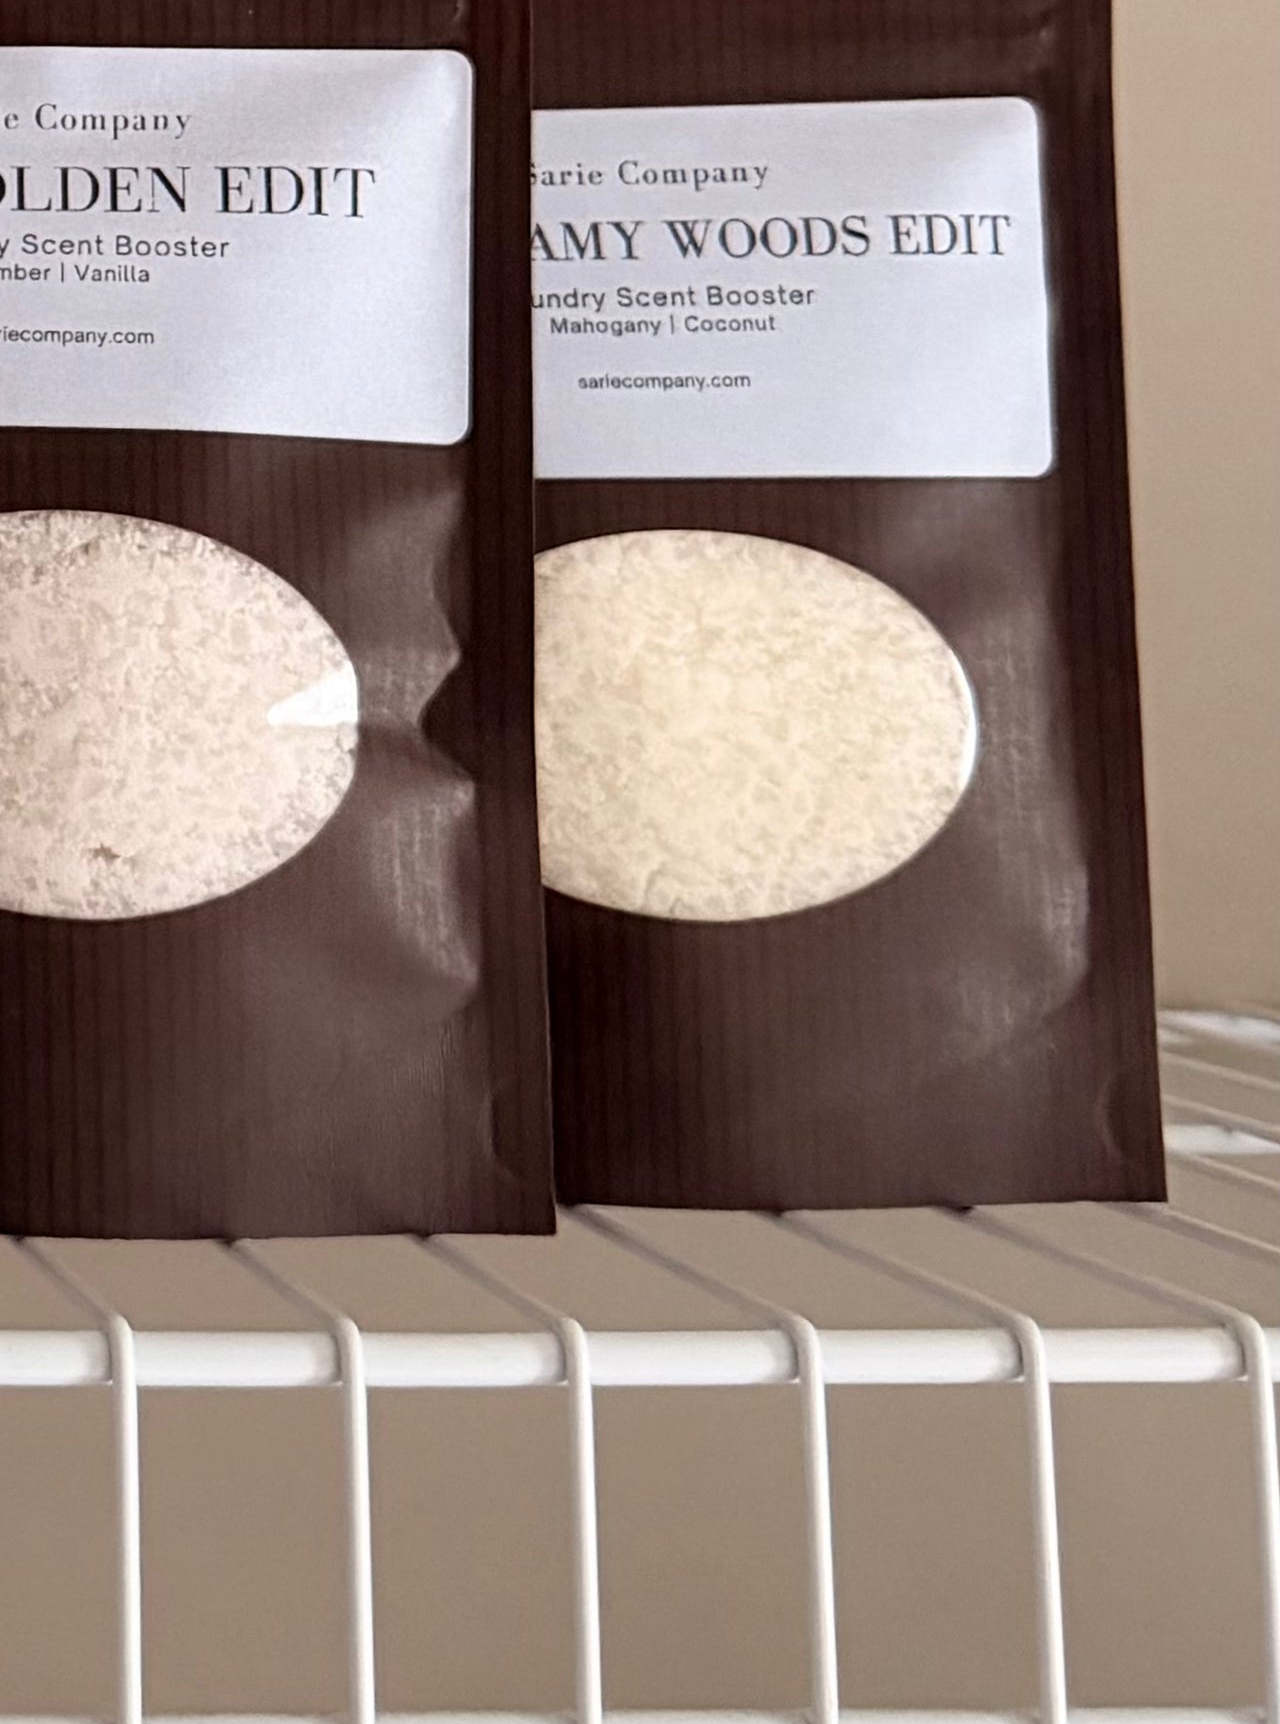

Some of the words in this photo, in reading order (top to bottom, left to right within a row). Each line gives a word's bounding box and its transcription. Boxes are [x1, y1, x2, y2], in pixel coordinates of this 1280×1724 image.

[35, 103, 191, 140] Company
[618, 160, 768, 192] Company
[214, 166, 375, 218] EDIT
[21, 233, 104, 256] Scent
[116, 235, 230, 258] Booster
[661, 215, 871, 259] WOODS
[886, 214, 1011, 255] EDIT
[74, 264, 150, 282] Vanilla
[617, 286, 697, 308] Scent
[706, 284, 815, 306] Booster
[550, 317, 661, 337] Mahogany
[685, 315, 775, 333] Coconut
[578, 374, 751, 392] sariecompany.com
